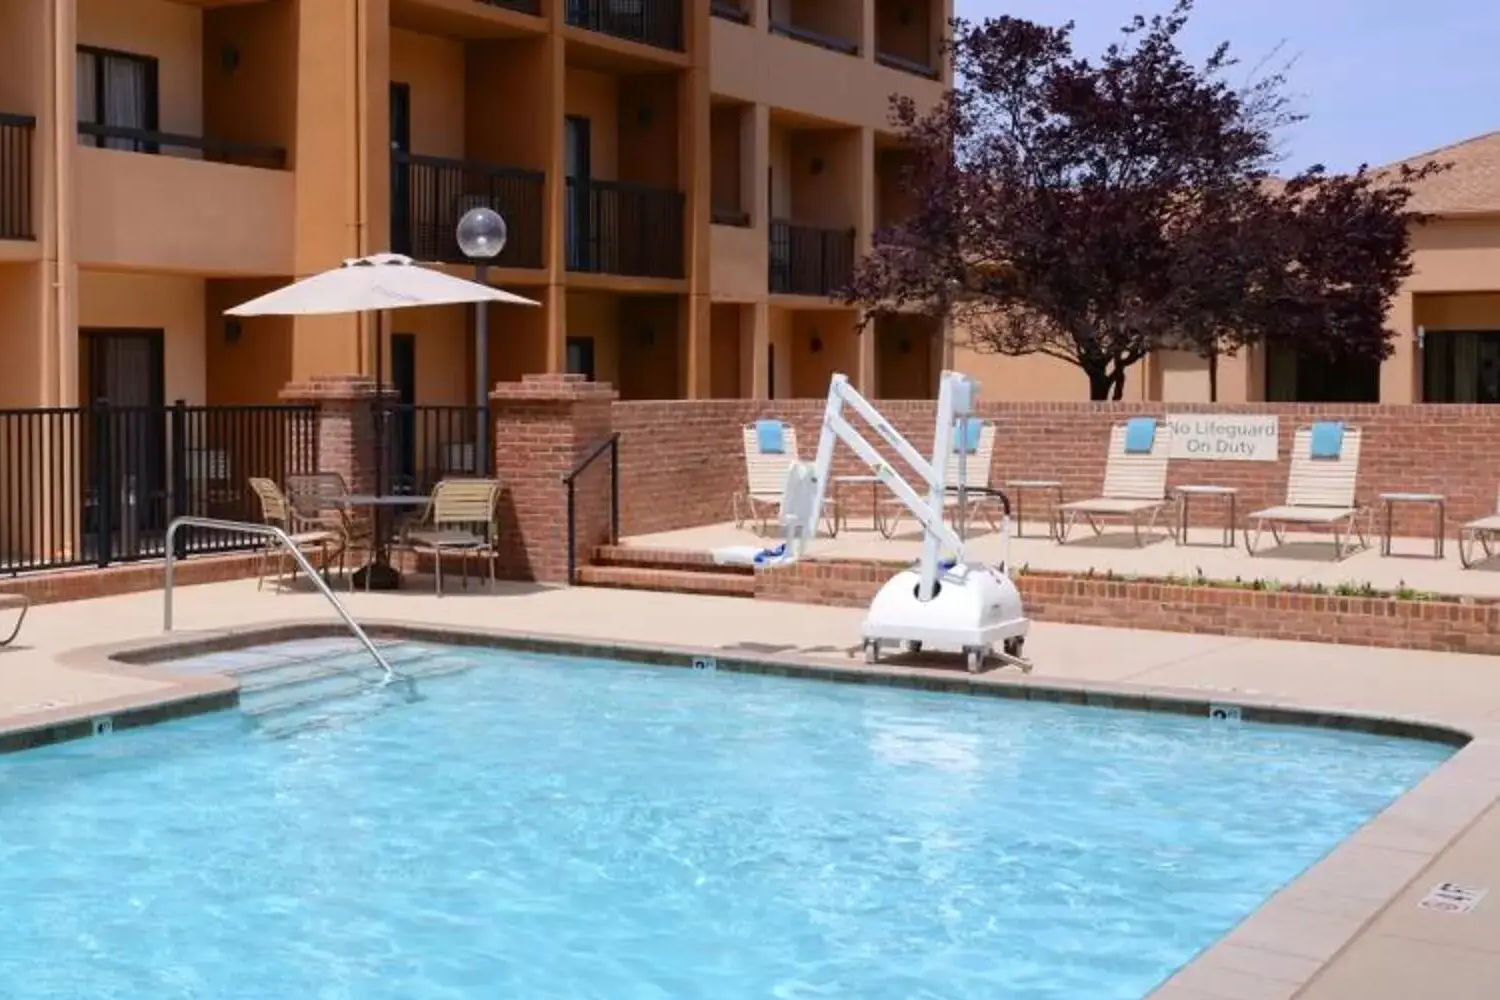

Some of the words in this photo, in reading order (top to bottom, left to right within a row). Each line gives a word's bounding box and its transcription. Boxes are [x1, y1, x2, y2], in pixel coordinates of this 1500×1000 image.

[1195, 421, 1275, 439] Lifeguard
[1187, 439, 1211, 453] On
[1216, 440, 1256, 457] Duty
